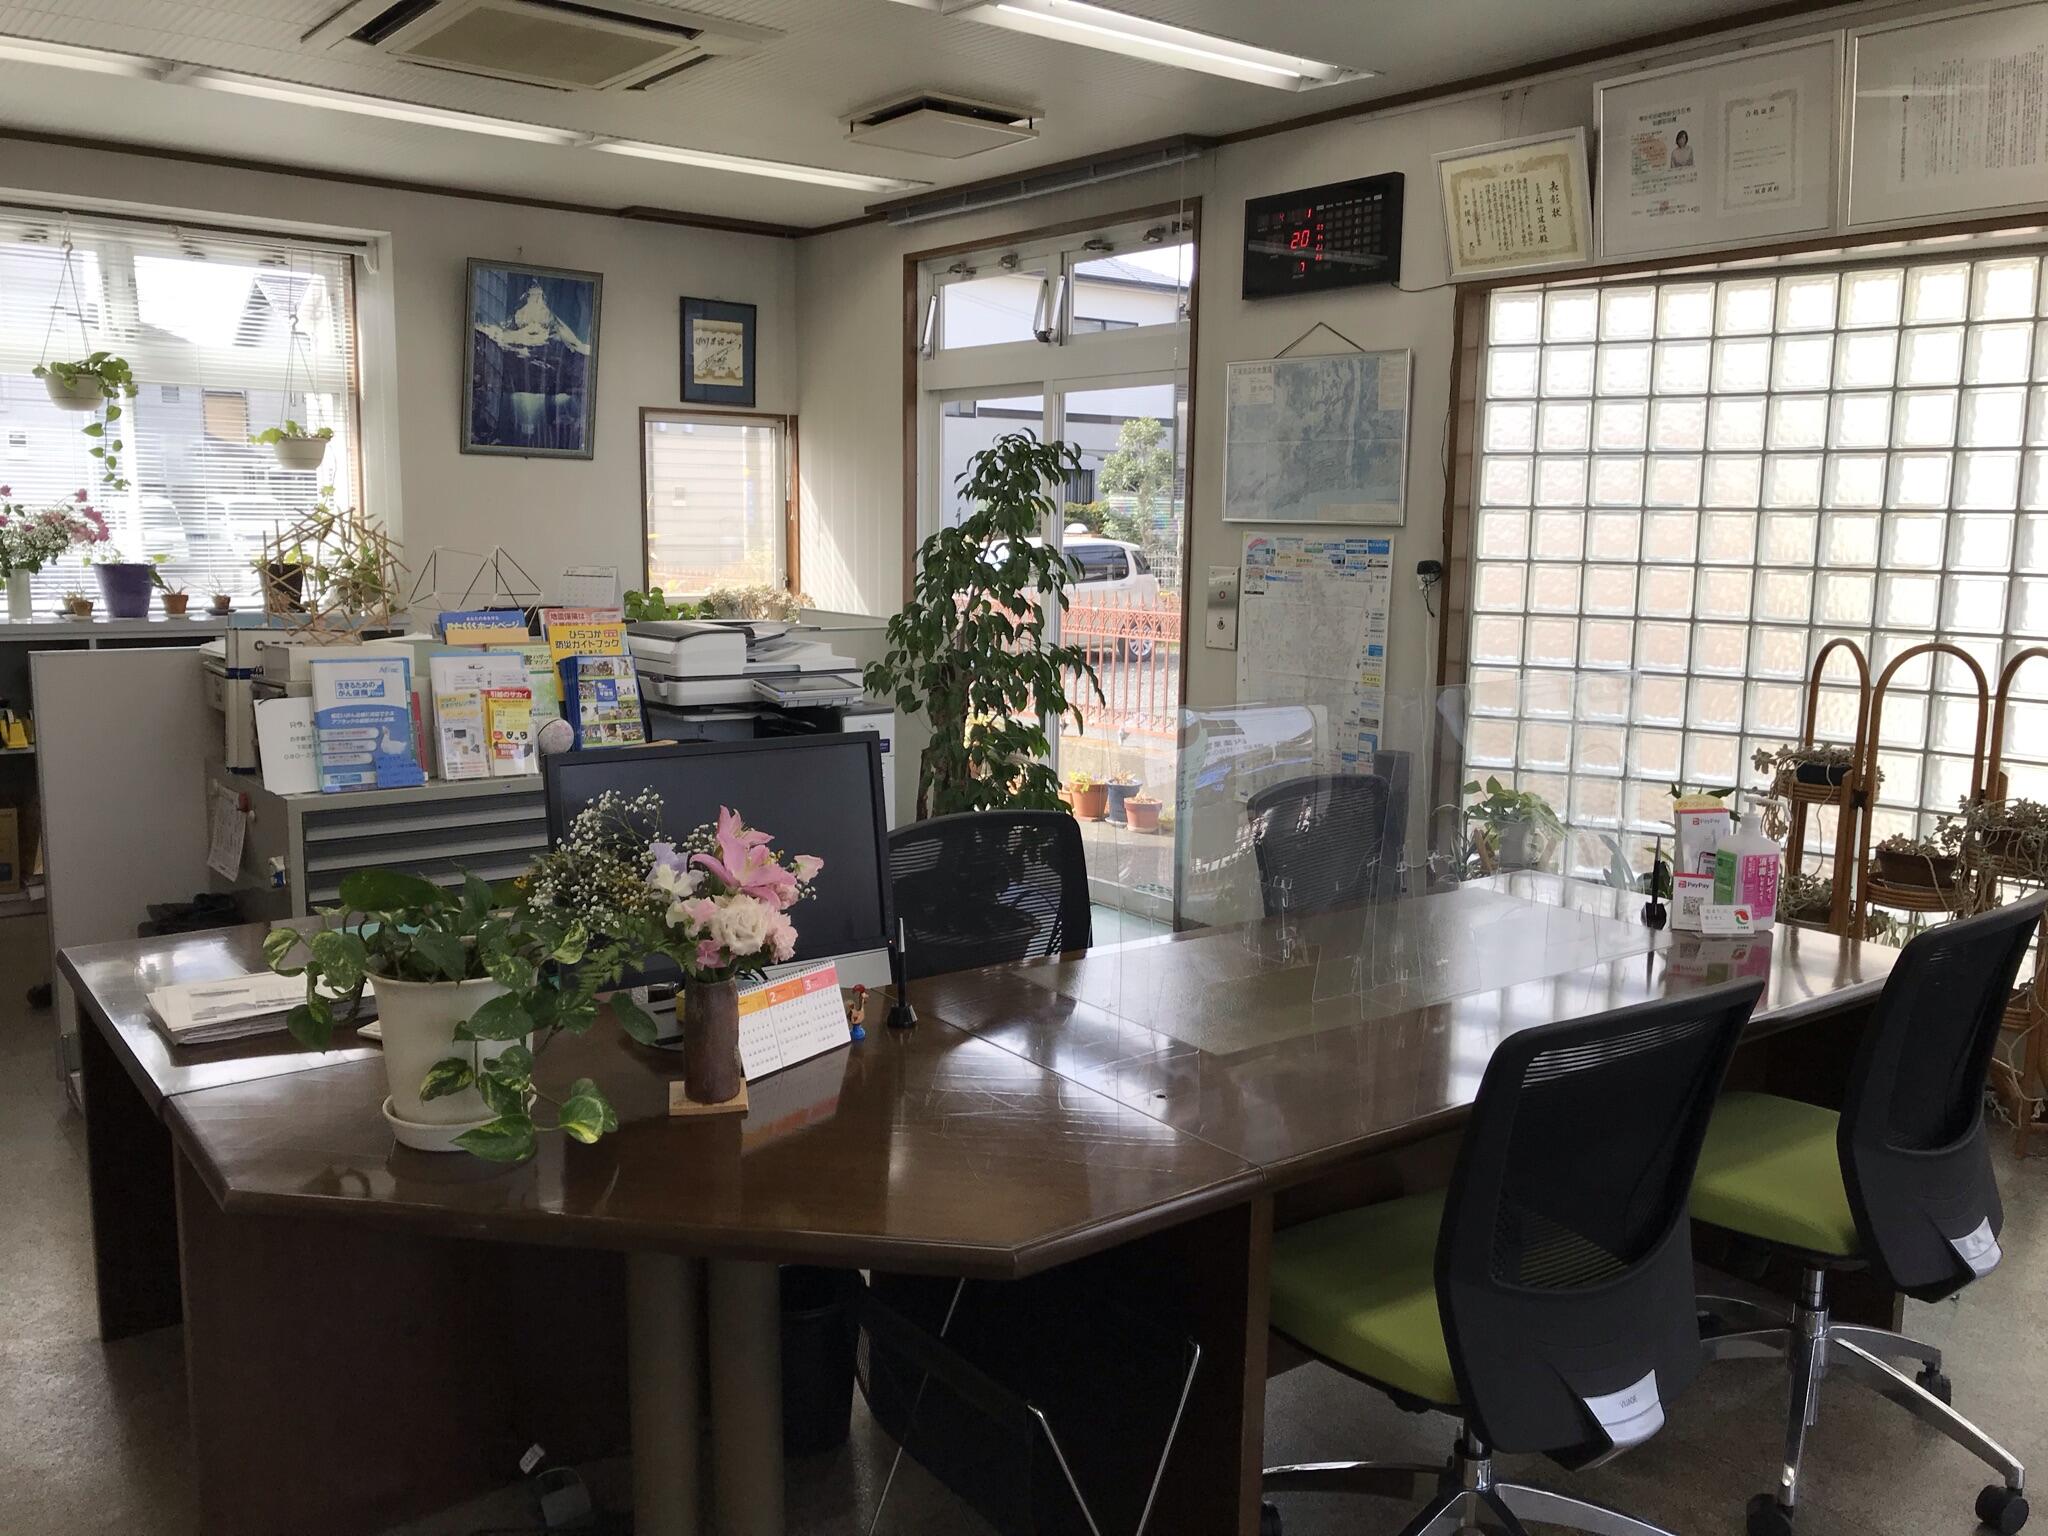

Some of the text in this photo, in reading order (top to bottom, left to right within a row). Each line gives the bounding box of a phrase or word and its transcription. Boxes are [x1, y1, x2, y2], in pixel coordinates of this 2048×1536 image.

[1290, 229, 1310, 250] 20
[568, 630, 602, 639] ひらつか
[555, 639, 619, 649] 防災ガイドブック
[337, 681, 376, 689] 生きるための
[338, 689, 369, 697] がん保険
[490, 691, 529, 699] 引越のサカイ
[1687, 880, 1710, 890] PayPay
[804, 980, 811, 990] 3
[769, 991, 776, 1003] 2
